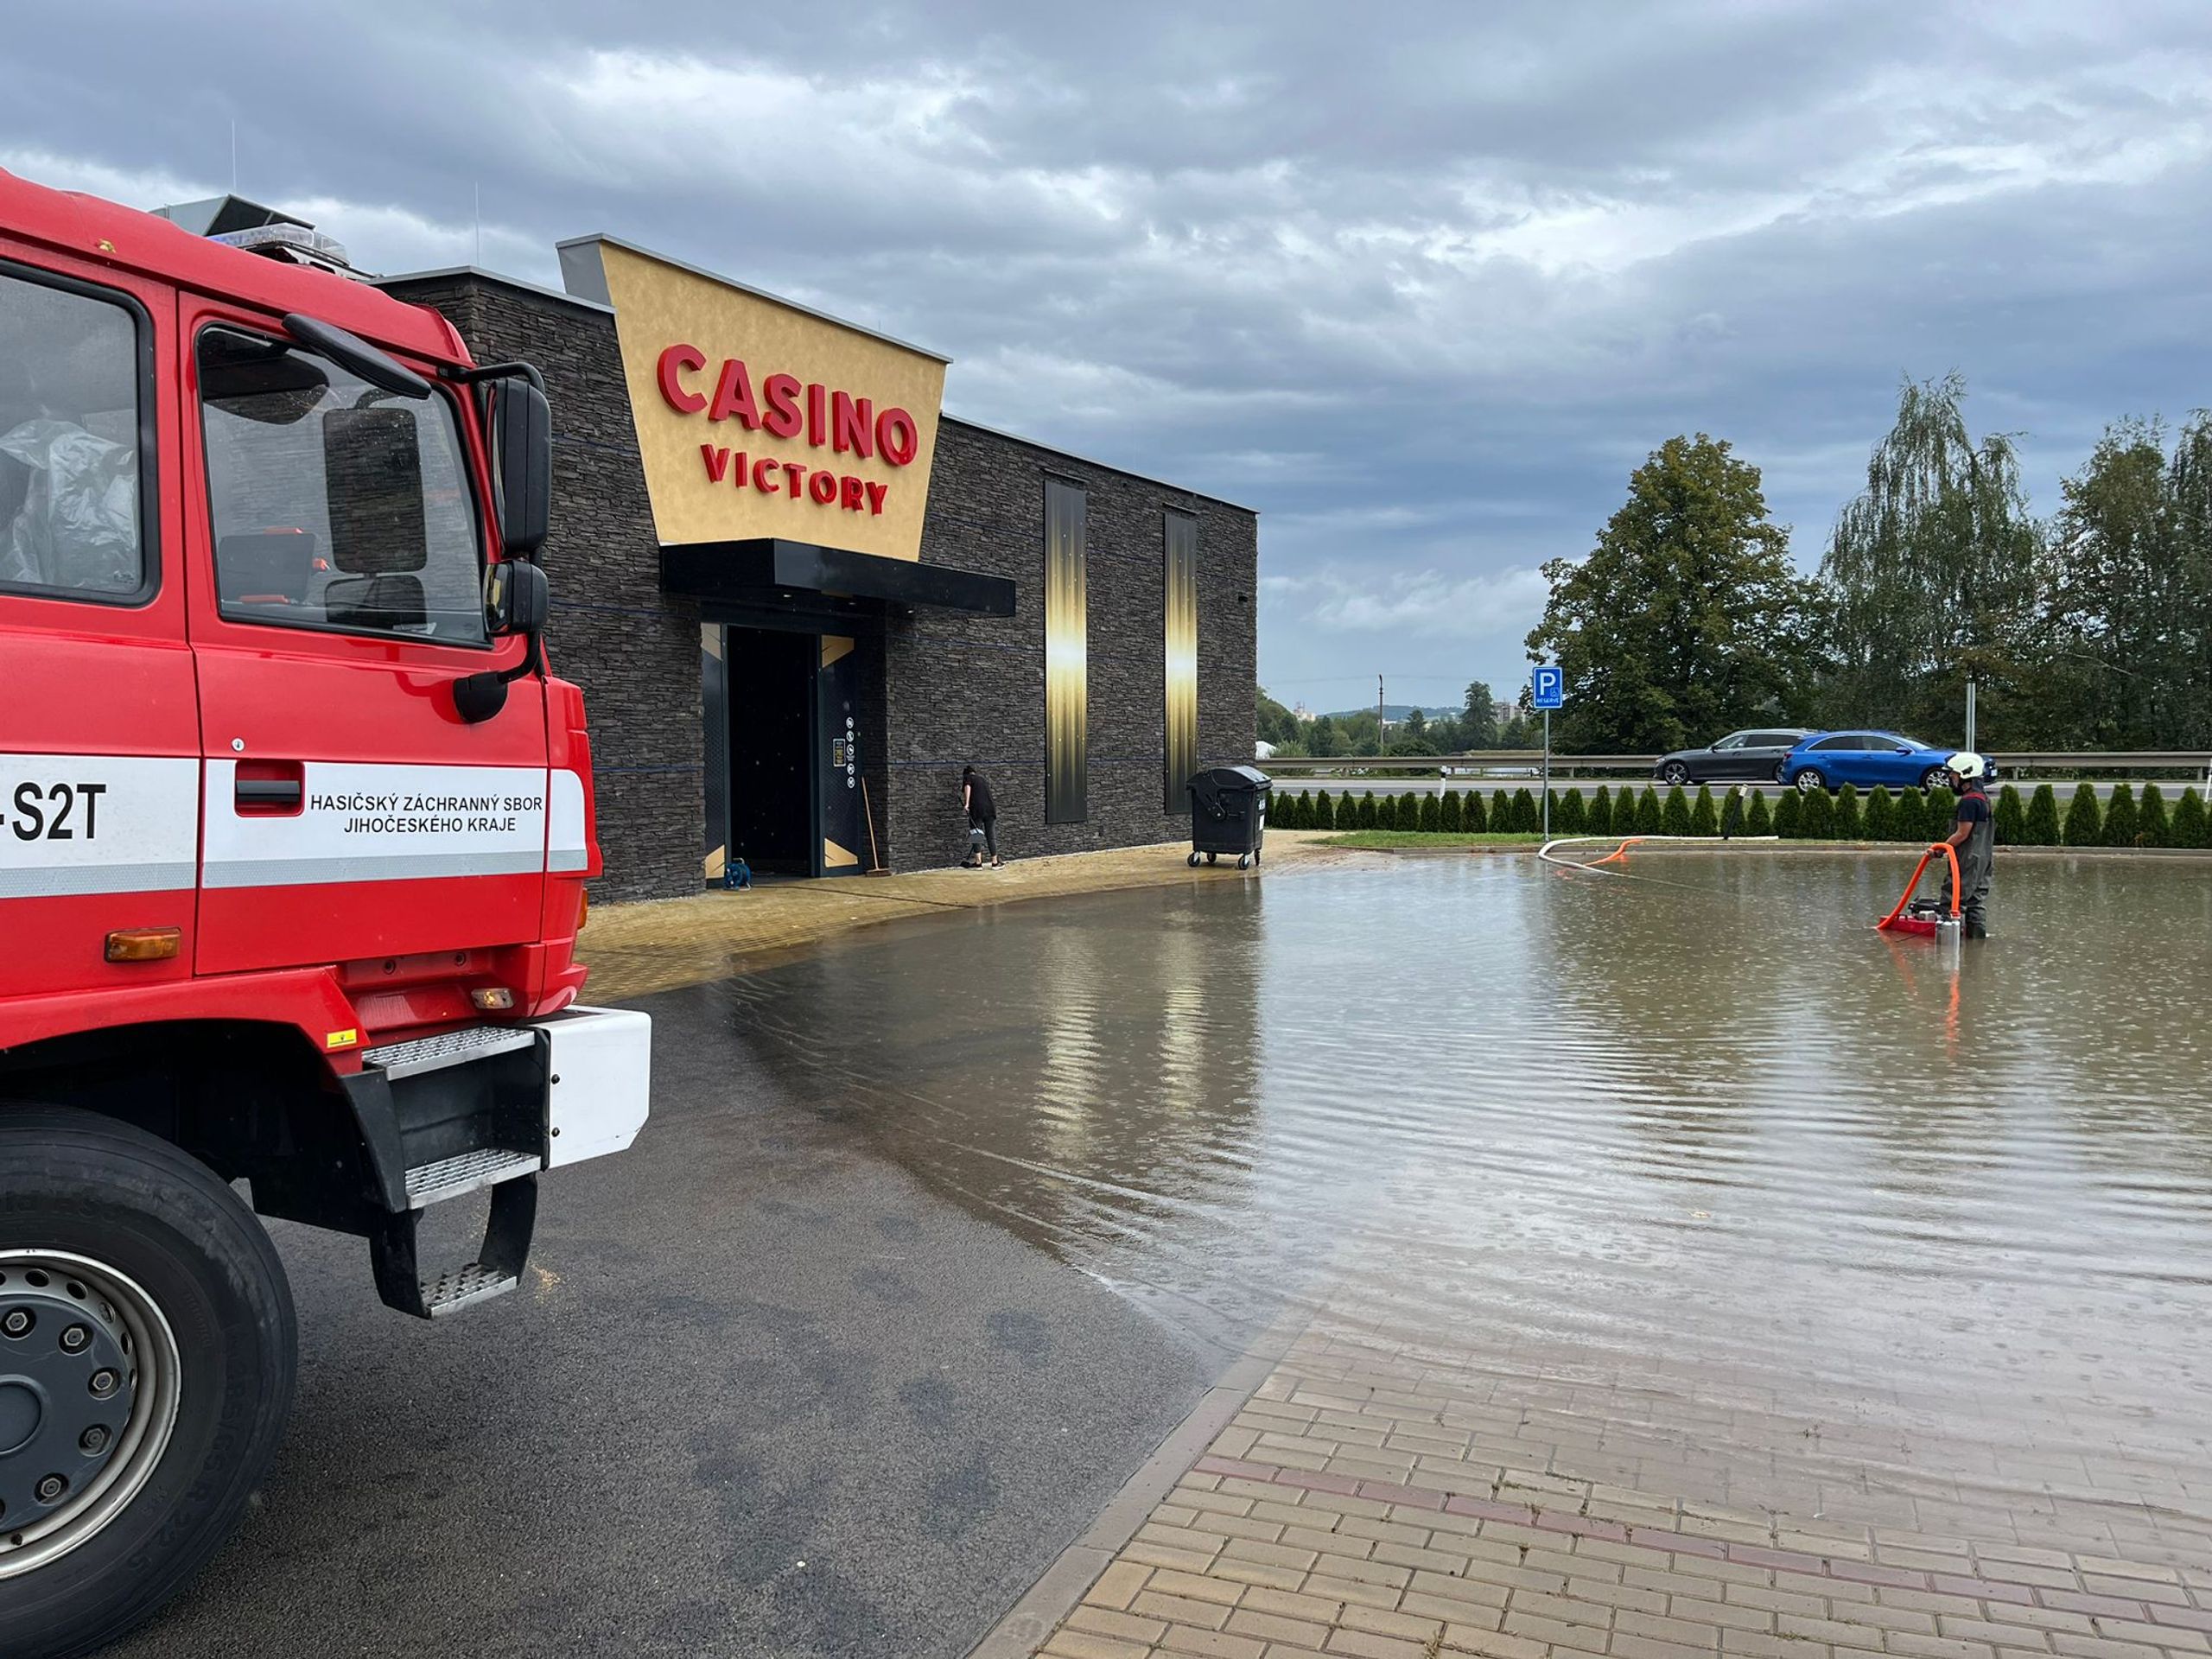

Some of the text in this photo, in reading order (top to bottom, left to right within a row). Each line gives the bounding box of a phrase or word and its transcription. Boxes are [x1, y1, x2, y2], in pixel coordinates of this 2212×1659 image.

[657, 344, 918, 467] CASINO
[700, 443, 888, 516] VICTORY
[1540, 672, 1556, 696] P
[0, 782, 106, 841] S2T
[310, 792, 543, 811] HASIČSKÝ ZÁCHRANNÝ SBOR
[344, 814, 517, 833] JIHOČESKÉHO KRAJE
